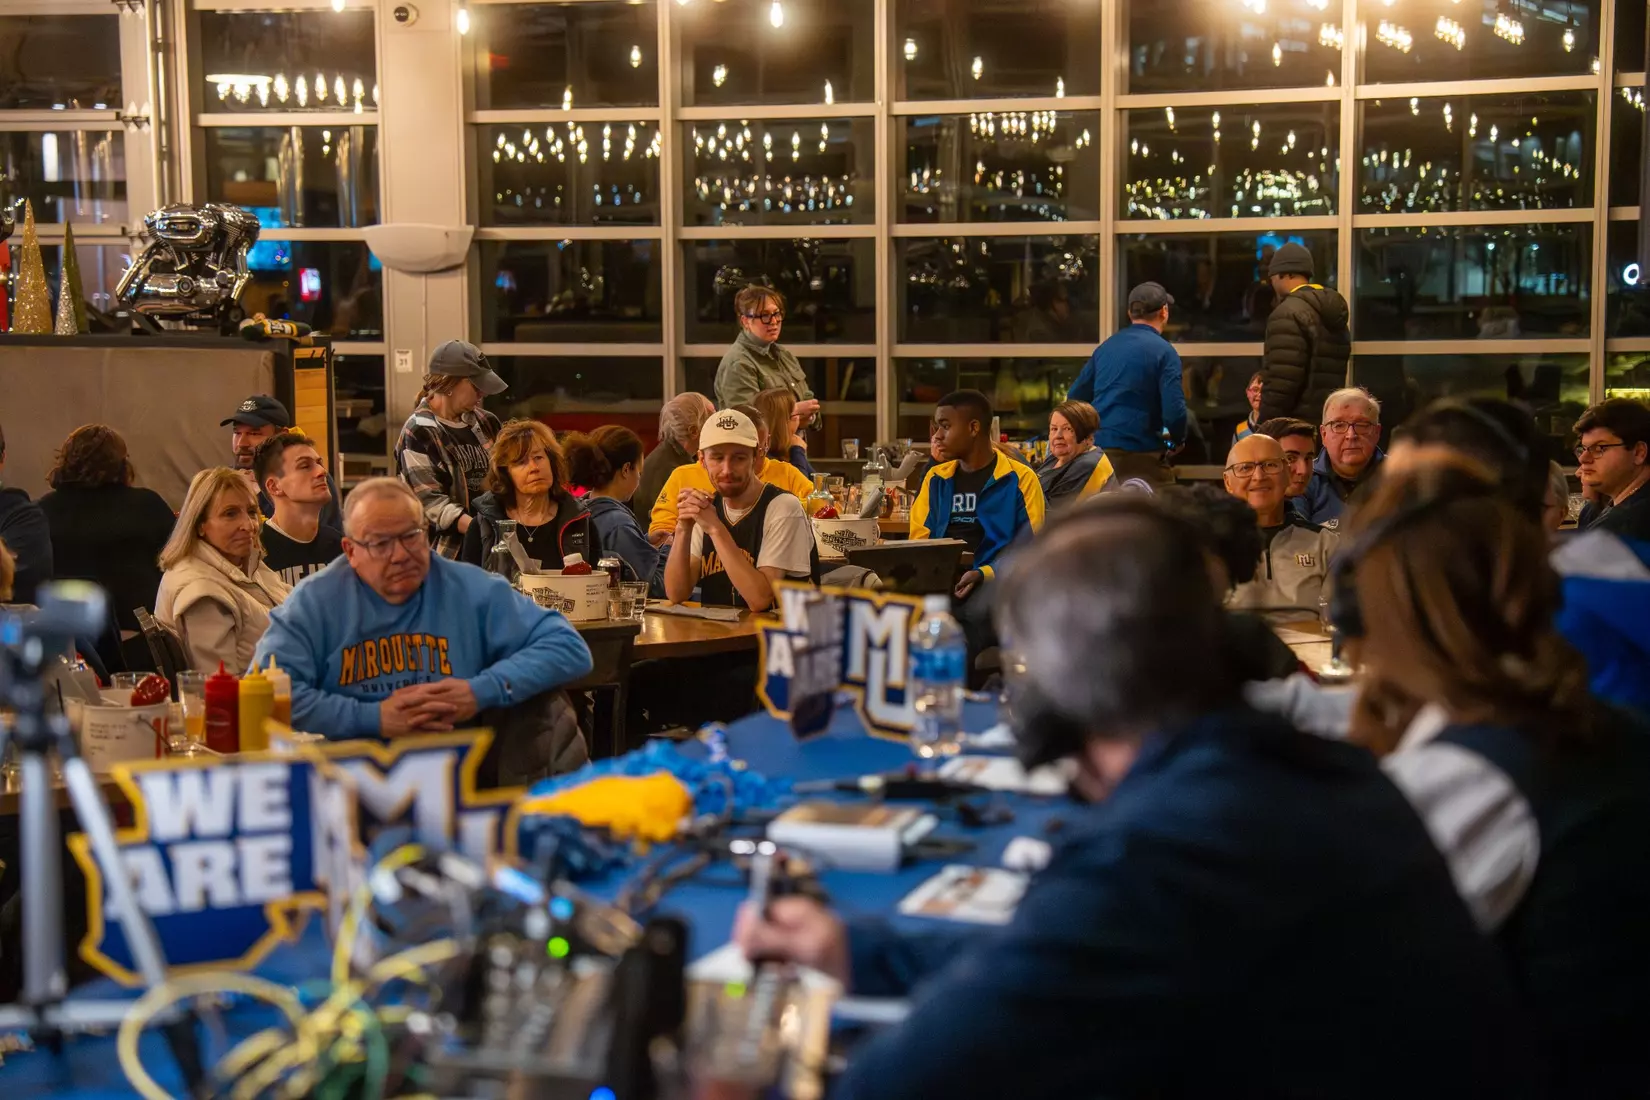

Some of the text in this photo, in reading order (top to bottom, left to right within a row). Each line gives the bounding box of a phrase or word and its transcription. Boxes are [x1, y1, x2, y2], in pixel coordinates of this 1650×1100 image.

[1295, 553, 1316, 568] MU
[339, 632, 453, 687] MARQUETTE
[140, 761, 291, 842] WE
